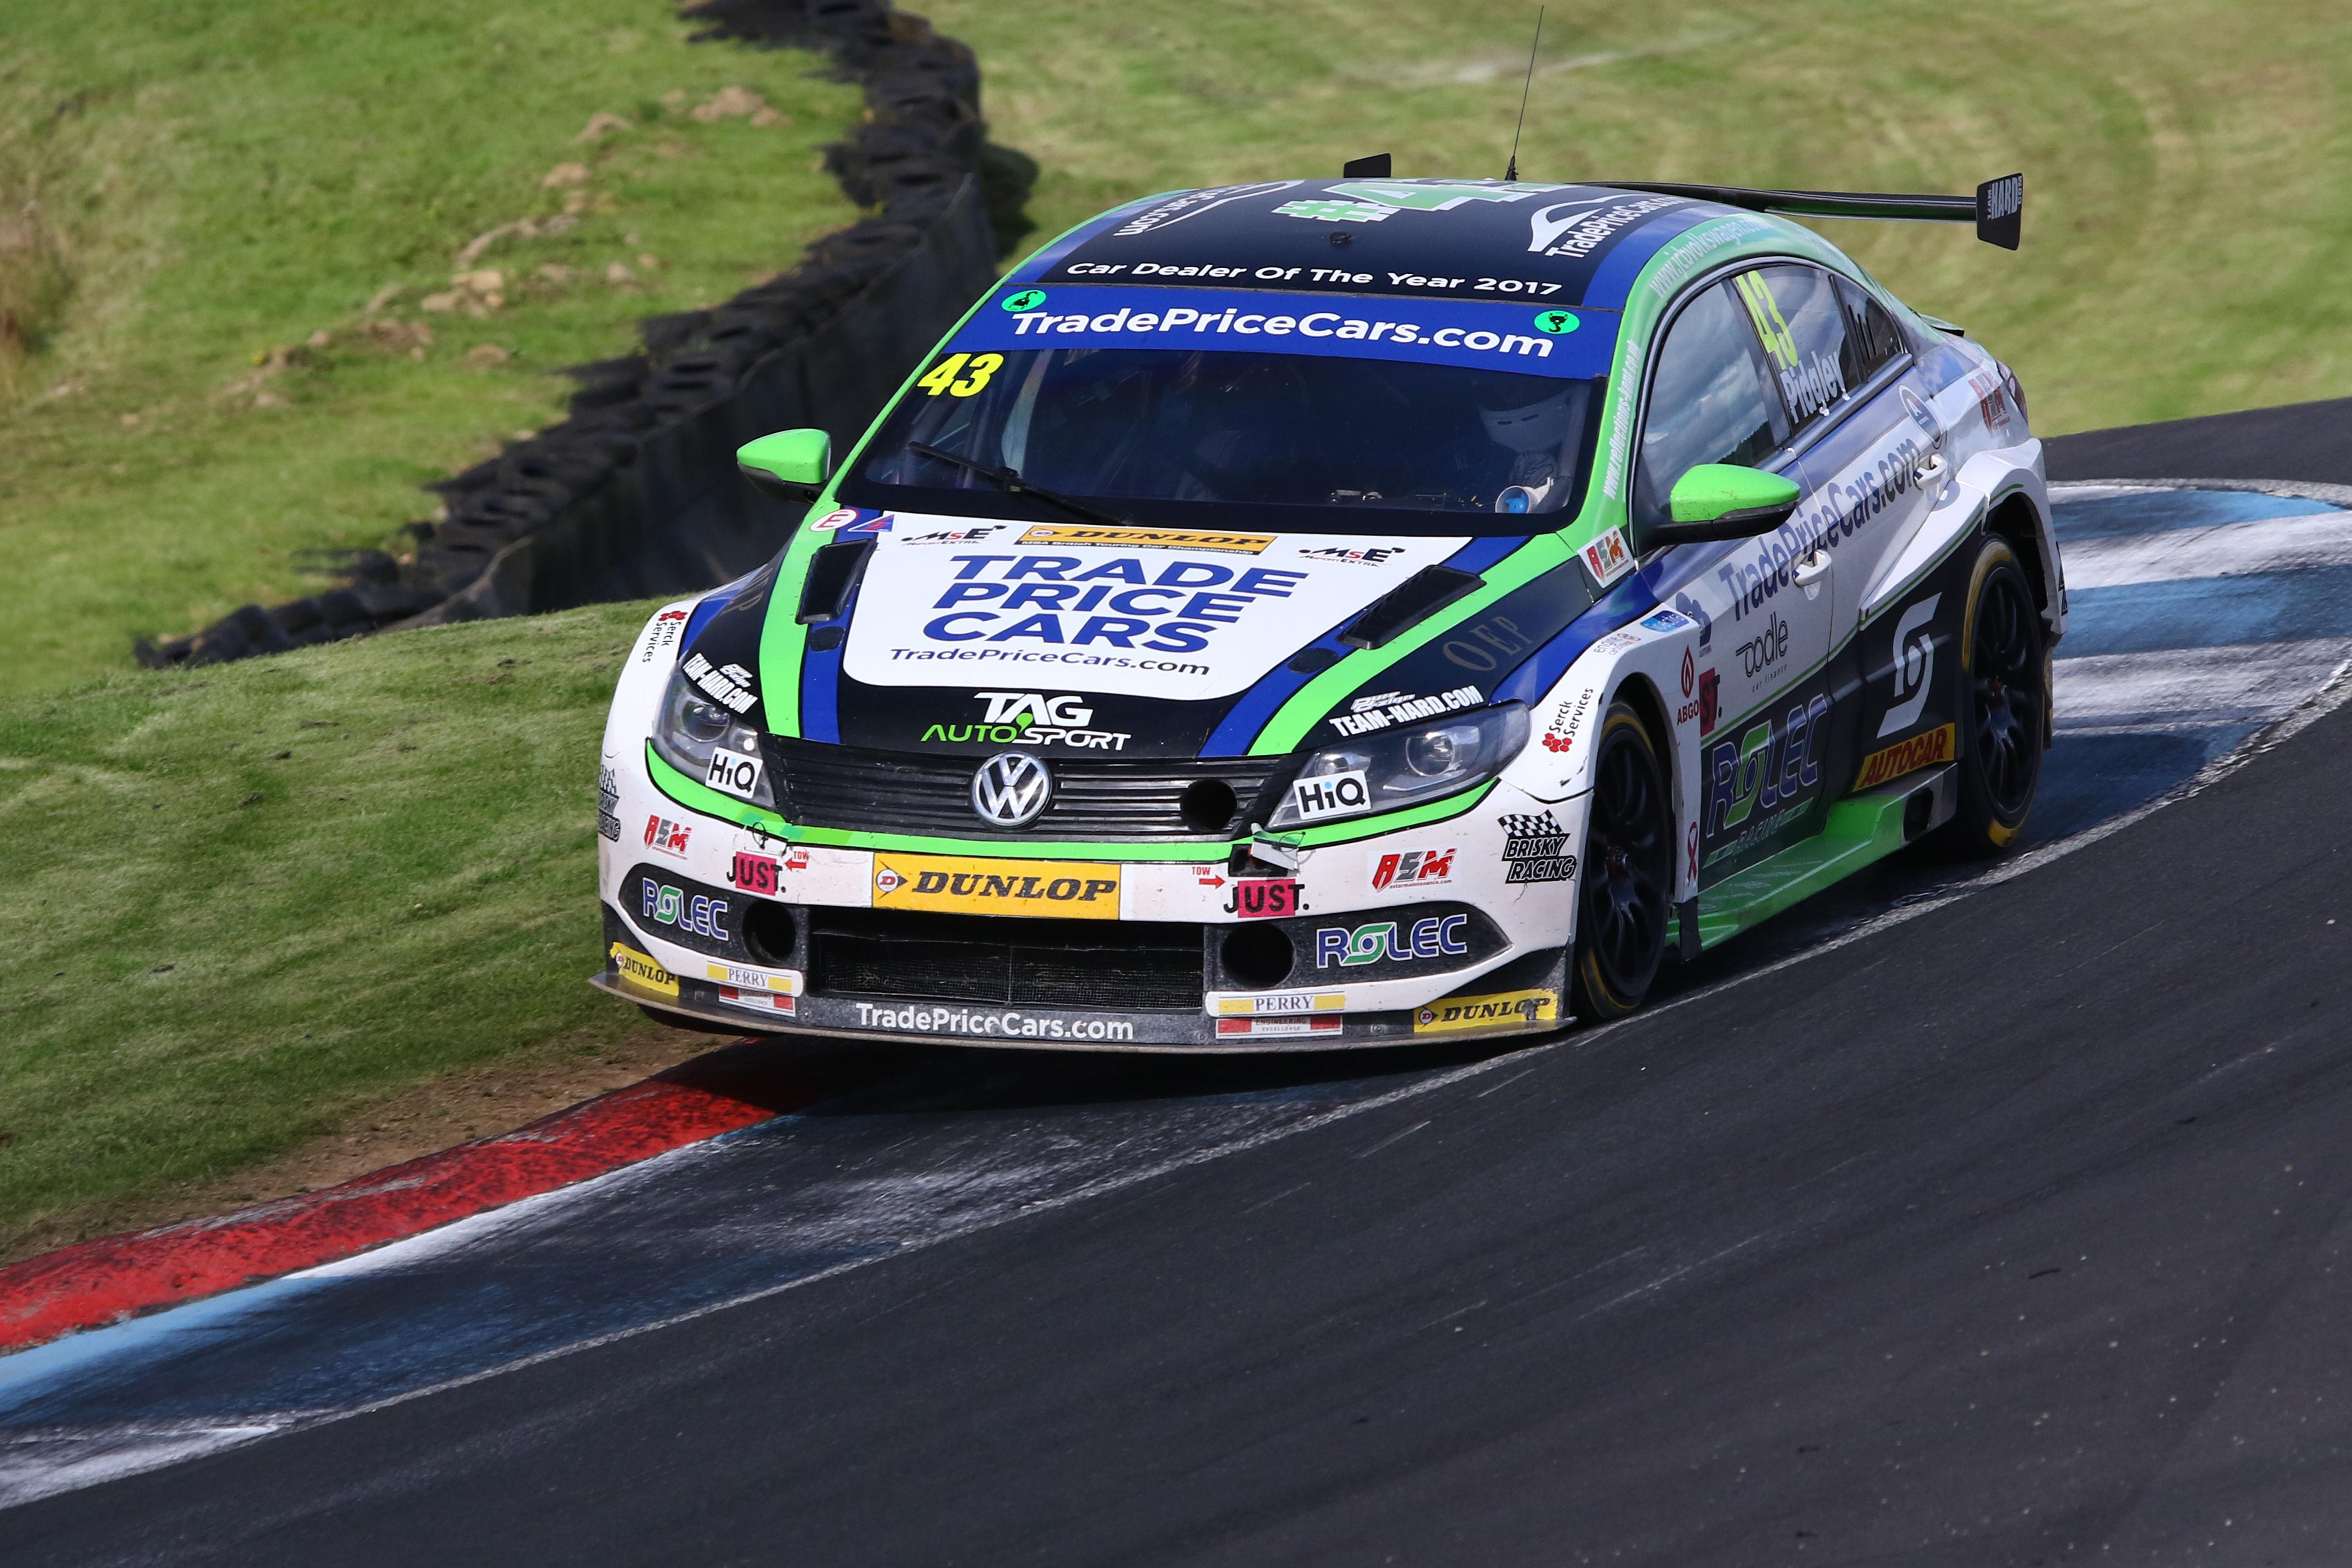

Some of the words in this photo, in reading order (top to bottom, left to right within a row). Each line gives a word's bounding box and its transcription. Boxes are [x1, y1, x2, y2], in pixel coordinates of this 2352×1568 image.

[1991, 177, 2018, 219] HARD
[1067, 262, 1127, 275] Car
[1131, 263, 1247, 278] Dealer
[1255, 266, 1301, 281] Of
[1311, 269, 1373, 284] The
[1387, 272, 1465, 289] Year
[1473, 278, 1562, 295] 2017
[1011, 308, 1554, 357] TradePriceCars.com
[1736, 270, 1798, 370] 43
[917, 353, 1004, 397] 43
[1065, 531, 1269, 544] DUNLOP
[1168, 545, 1254, 555] Championship
[949, 555, 1310, 597] TRADE
[932, 583, 1258, 623] PRICE
[642, 622, 666, 663] Services
[662, 622, 682, 647] Serck
[923, 611, 1218, 653] CARS
[1442, 616, 1533, 672] OEP
[890, 648, 1210, 676] TradePriceCars.com
[682, 652, 758, 714] TEAM-HARD.COM
[1700, 674, 1722, 726] ST.
[973, 692, 1094, 727] TAG
[1328, 685, 1484, 737] TEAM-HARD.COM
[1549, 701, 1572, 733] Serck
[1563, 688, 1594, 737] Services
[919, 721, 1131, 751] AUTOSPORT
[708, 753, 756, 793] HiQ
[1707, 694, 1828, 838] ROLEC
[1861, 726, 1947, 788] AUTOCAR
[1299, 777, 1366, 814] HiQ
[1506, 836, 1566, 858] BRISKY
[726, 855, 786, 894] JUST.
[912, 871, 1117, 901] DUNLOP
[1192, 866, 1210, 876] TOW
[1510, 856, 1576, 881] RACING
[643, 877, 729, 941] ROLEC
[1223, 883, 1310, 914] JUST.
[1316, 914, 1467, 968] ROLEC
[623, 956, 675, 985] DUNLOP
[728, 968, 768, 987] PERRY
[1255, 996, 1315, 1011] PERRY
[1255, 1017, 1307, 1025] ENGINEERING
